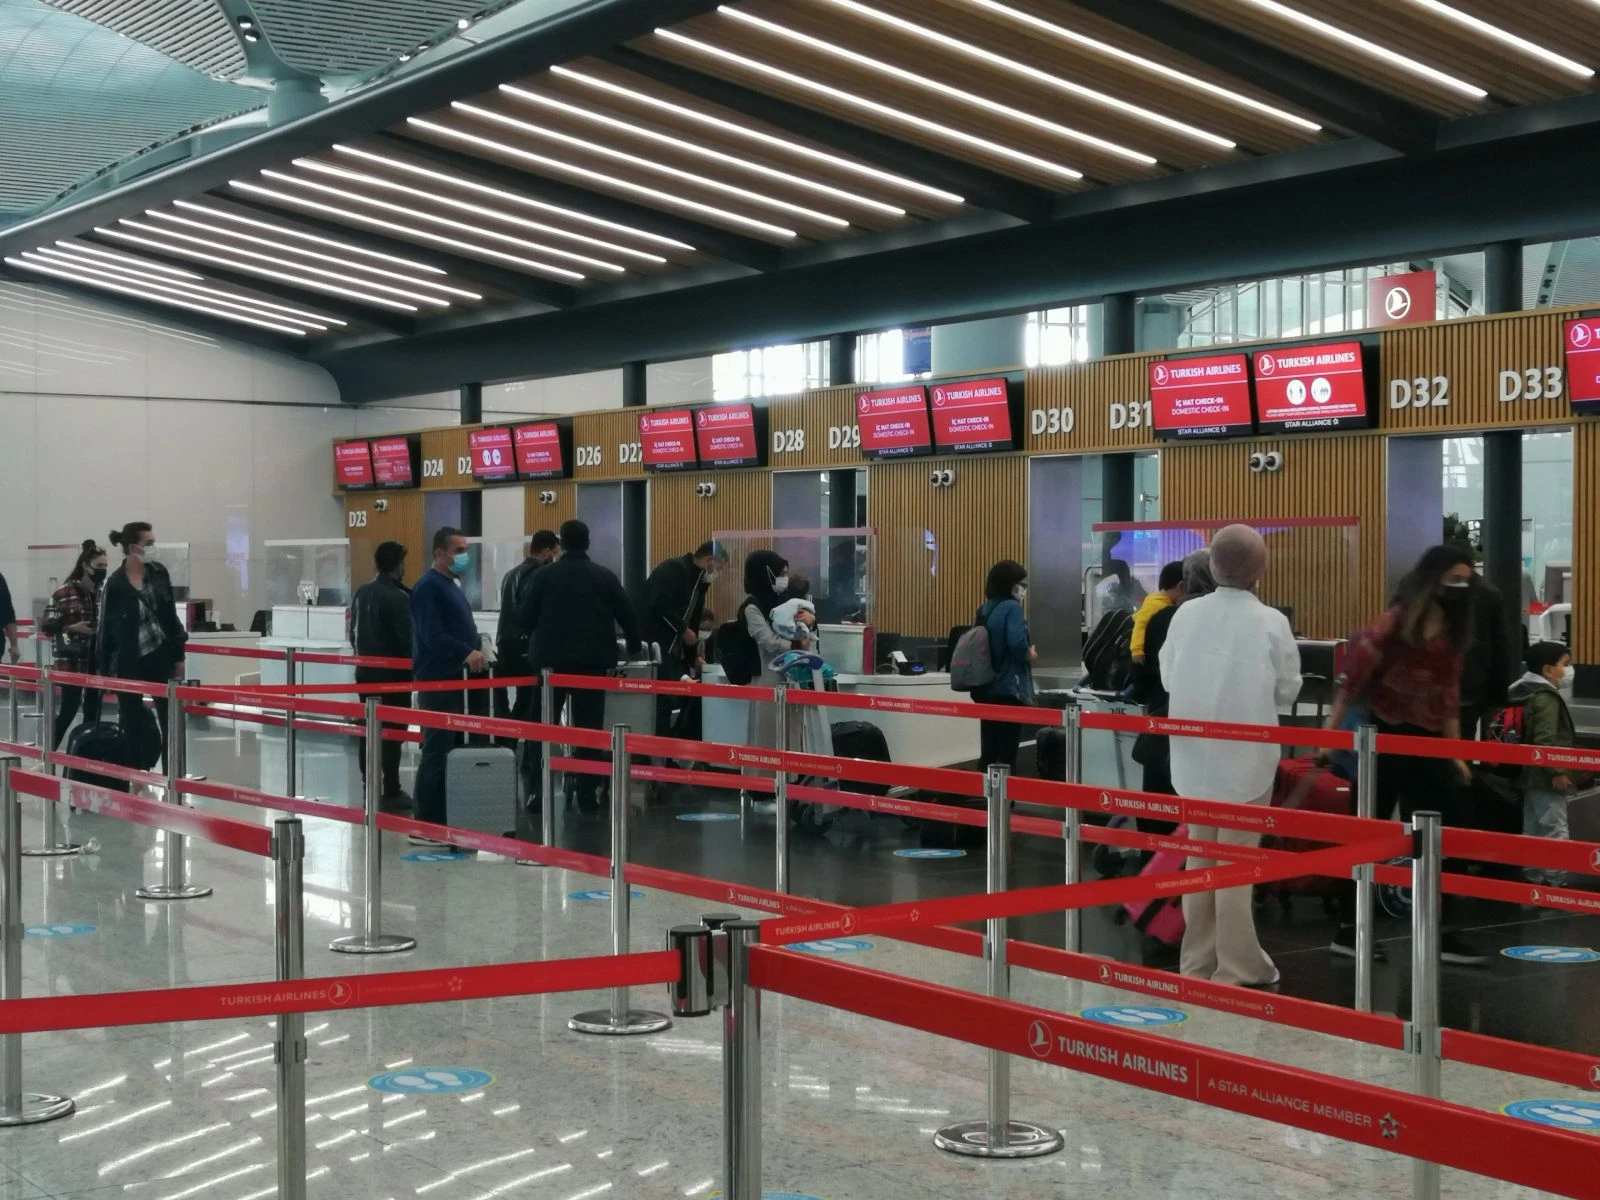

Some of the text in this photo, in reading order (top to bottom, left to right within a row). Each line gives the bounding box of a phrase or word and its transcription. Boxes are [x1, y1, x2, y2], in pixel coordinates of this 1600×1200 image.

[1277, 352, 1355, 369] TURKISH AIRLINES
[1170, 364, 1241, 379] TURKISH AIRLINES
[1390, 375, 1449, 409] D32
[1499, 366, 1562, 402] D33
[871, 394, 922, 407] TURKISH AIRLINES
[946, 387, 1002, 400] TURKISH AIRLINES
[1183, 398, 1194, 406] HAT
[1195, 397, 1224, 405] CHECK-IN
[708, 411, 750, 422] TURKISH AIRLINES
[1110, 400, 1152, 430] D31
[1172, 405, 1229, 416] DOMESTIC CHECK-IN
[650, 416, 689, 427] TURKISH AIRLINES
[949, 423, 994, 433] DOMESTIC CHECK-IN
[966, 416, 990, 424] CHECK-IN
[1031, 407, 1074, 435] D30
[1285, 418, 1332, 429] STAR ALLIANCE
[829, 425, 861, 450] D29
[873, 430, 895, 439] DOMESTIC
[1193, 426, 1220, 434] ALLIANCE
[773, 429, 804, 453] D28
[576, 446, 601, 466] D26
[423, 459, 444, 477] D24
[458, 456, 473, 475] D2
[349, 511, 367, 528] D23
[1547, 753, 1600, 765] TURKISH AIRLIN
[1115, 798, 1179, 815] TURKISH AIRLINES
[1577, 898, 1600, 908] AIRLIN
[775, 921, 840, 936] TURKISH AIRLINES
[1114, 972, 1179, 994] TURKISH AIRLINES
[220, 989, 327, 1006] TURKISH AIRLINES
[1058, 1036, 1188, 1083] TURKISH AIRLINES
[1208, 1078, 1372, 1127] A STAR ALLIANCE MEMBER
